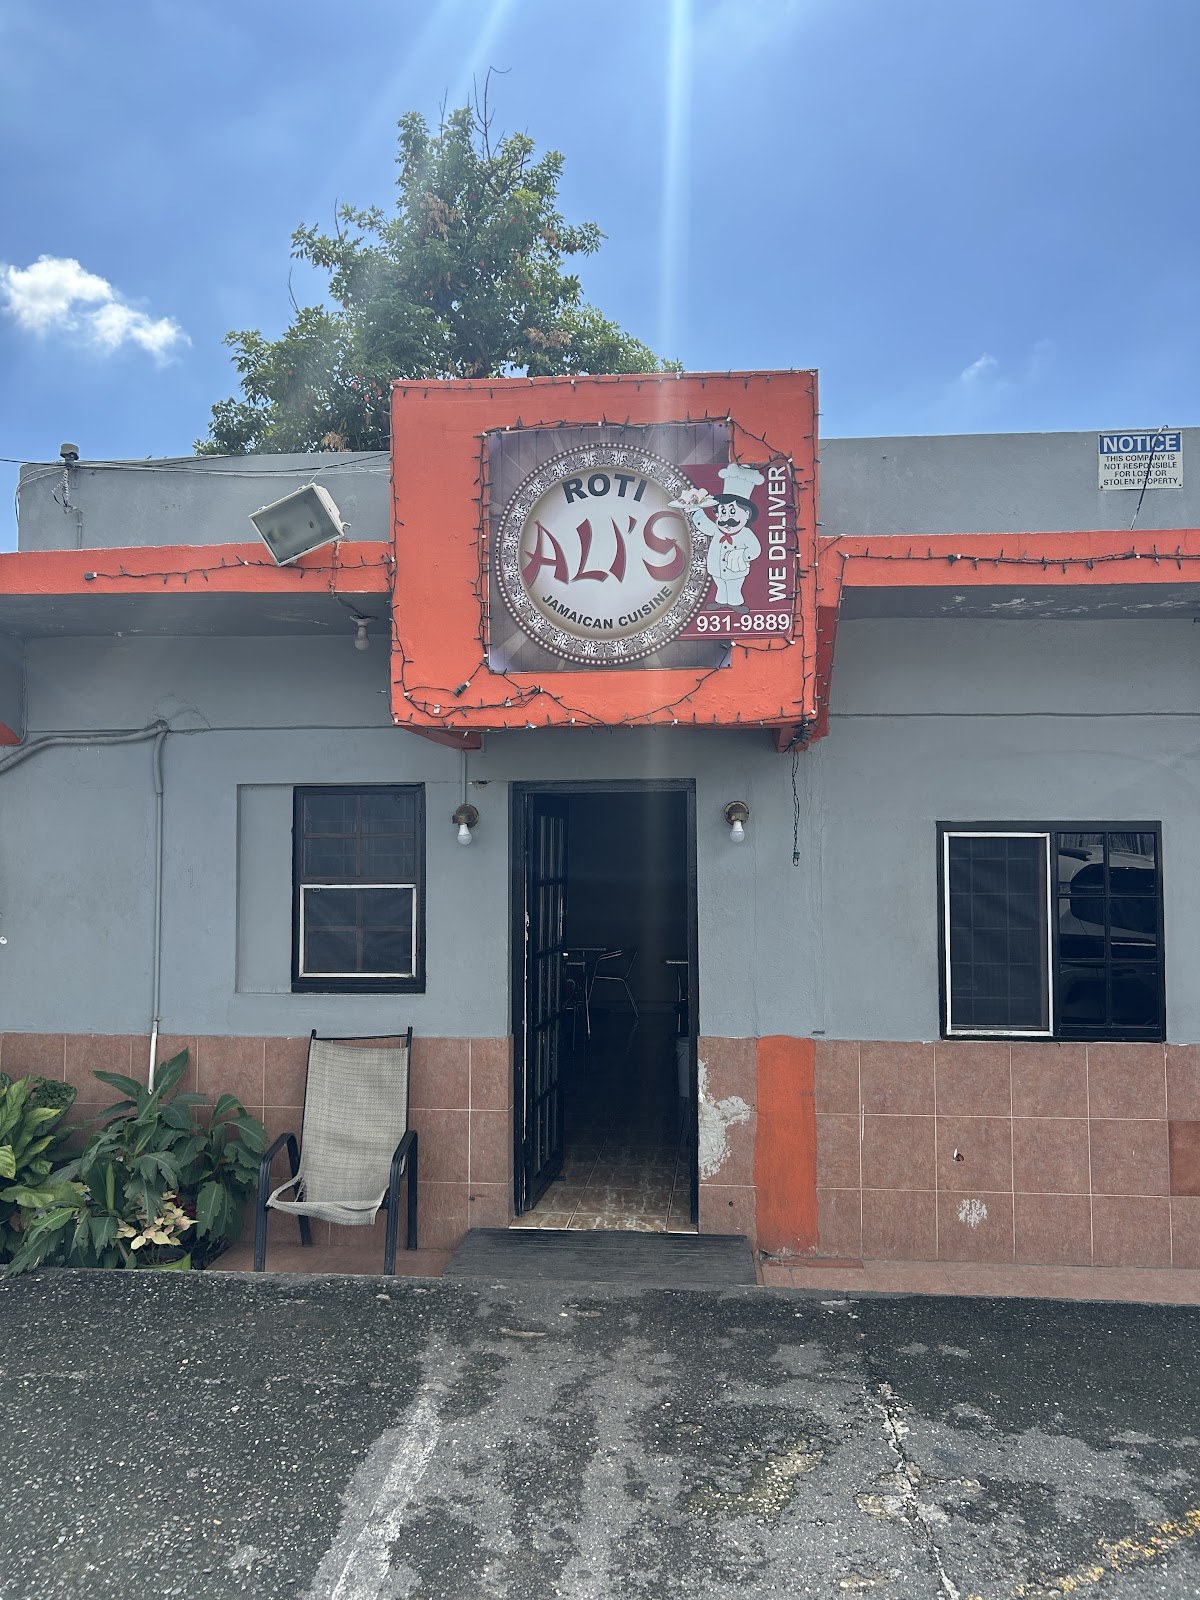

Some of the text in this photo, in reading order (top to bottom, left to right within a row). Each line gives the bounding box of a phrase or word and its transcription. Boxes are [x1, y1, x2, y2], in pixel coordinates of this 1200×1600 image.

[1103, 435, 1177, 452] NOTICE
[562, 474, 648, 504] ROTI
[521, 511, 687, 589] ALI'S
[768, 467, 786, 602] WE DELIVER
[542, 586, 672, 629] JAMAICAN CUISINE
[697, 613, 790, 632] 931-9889
